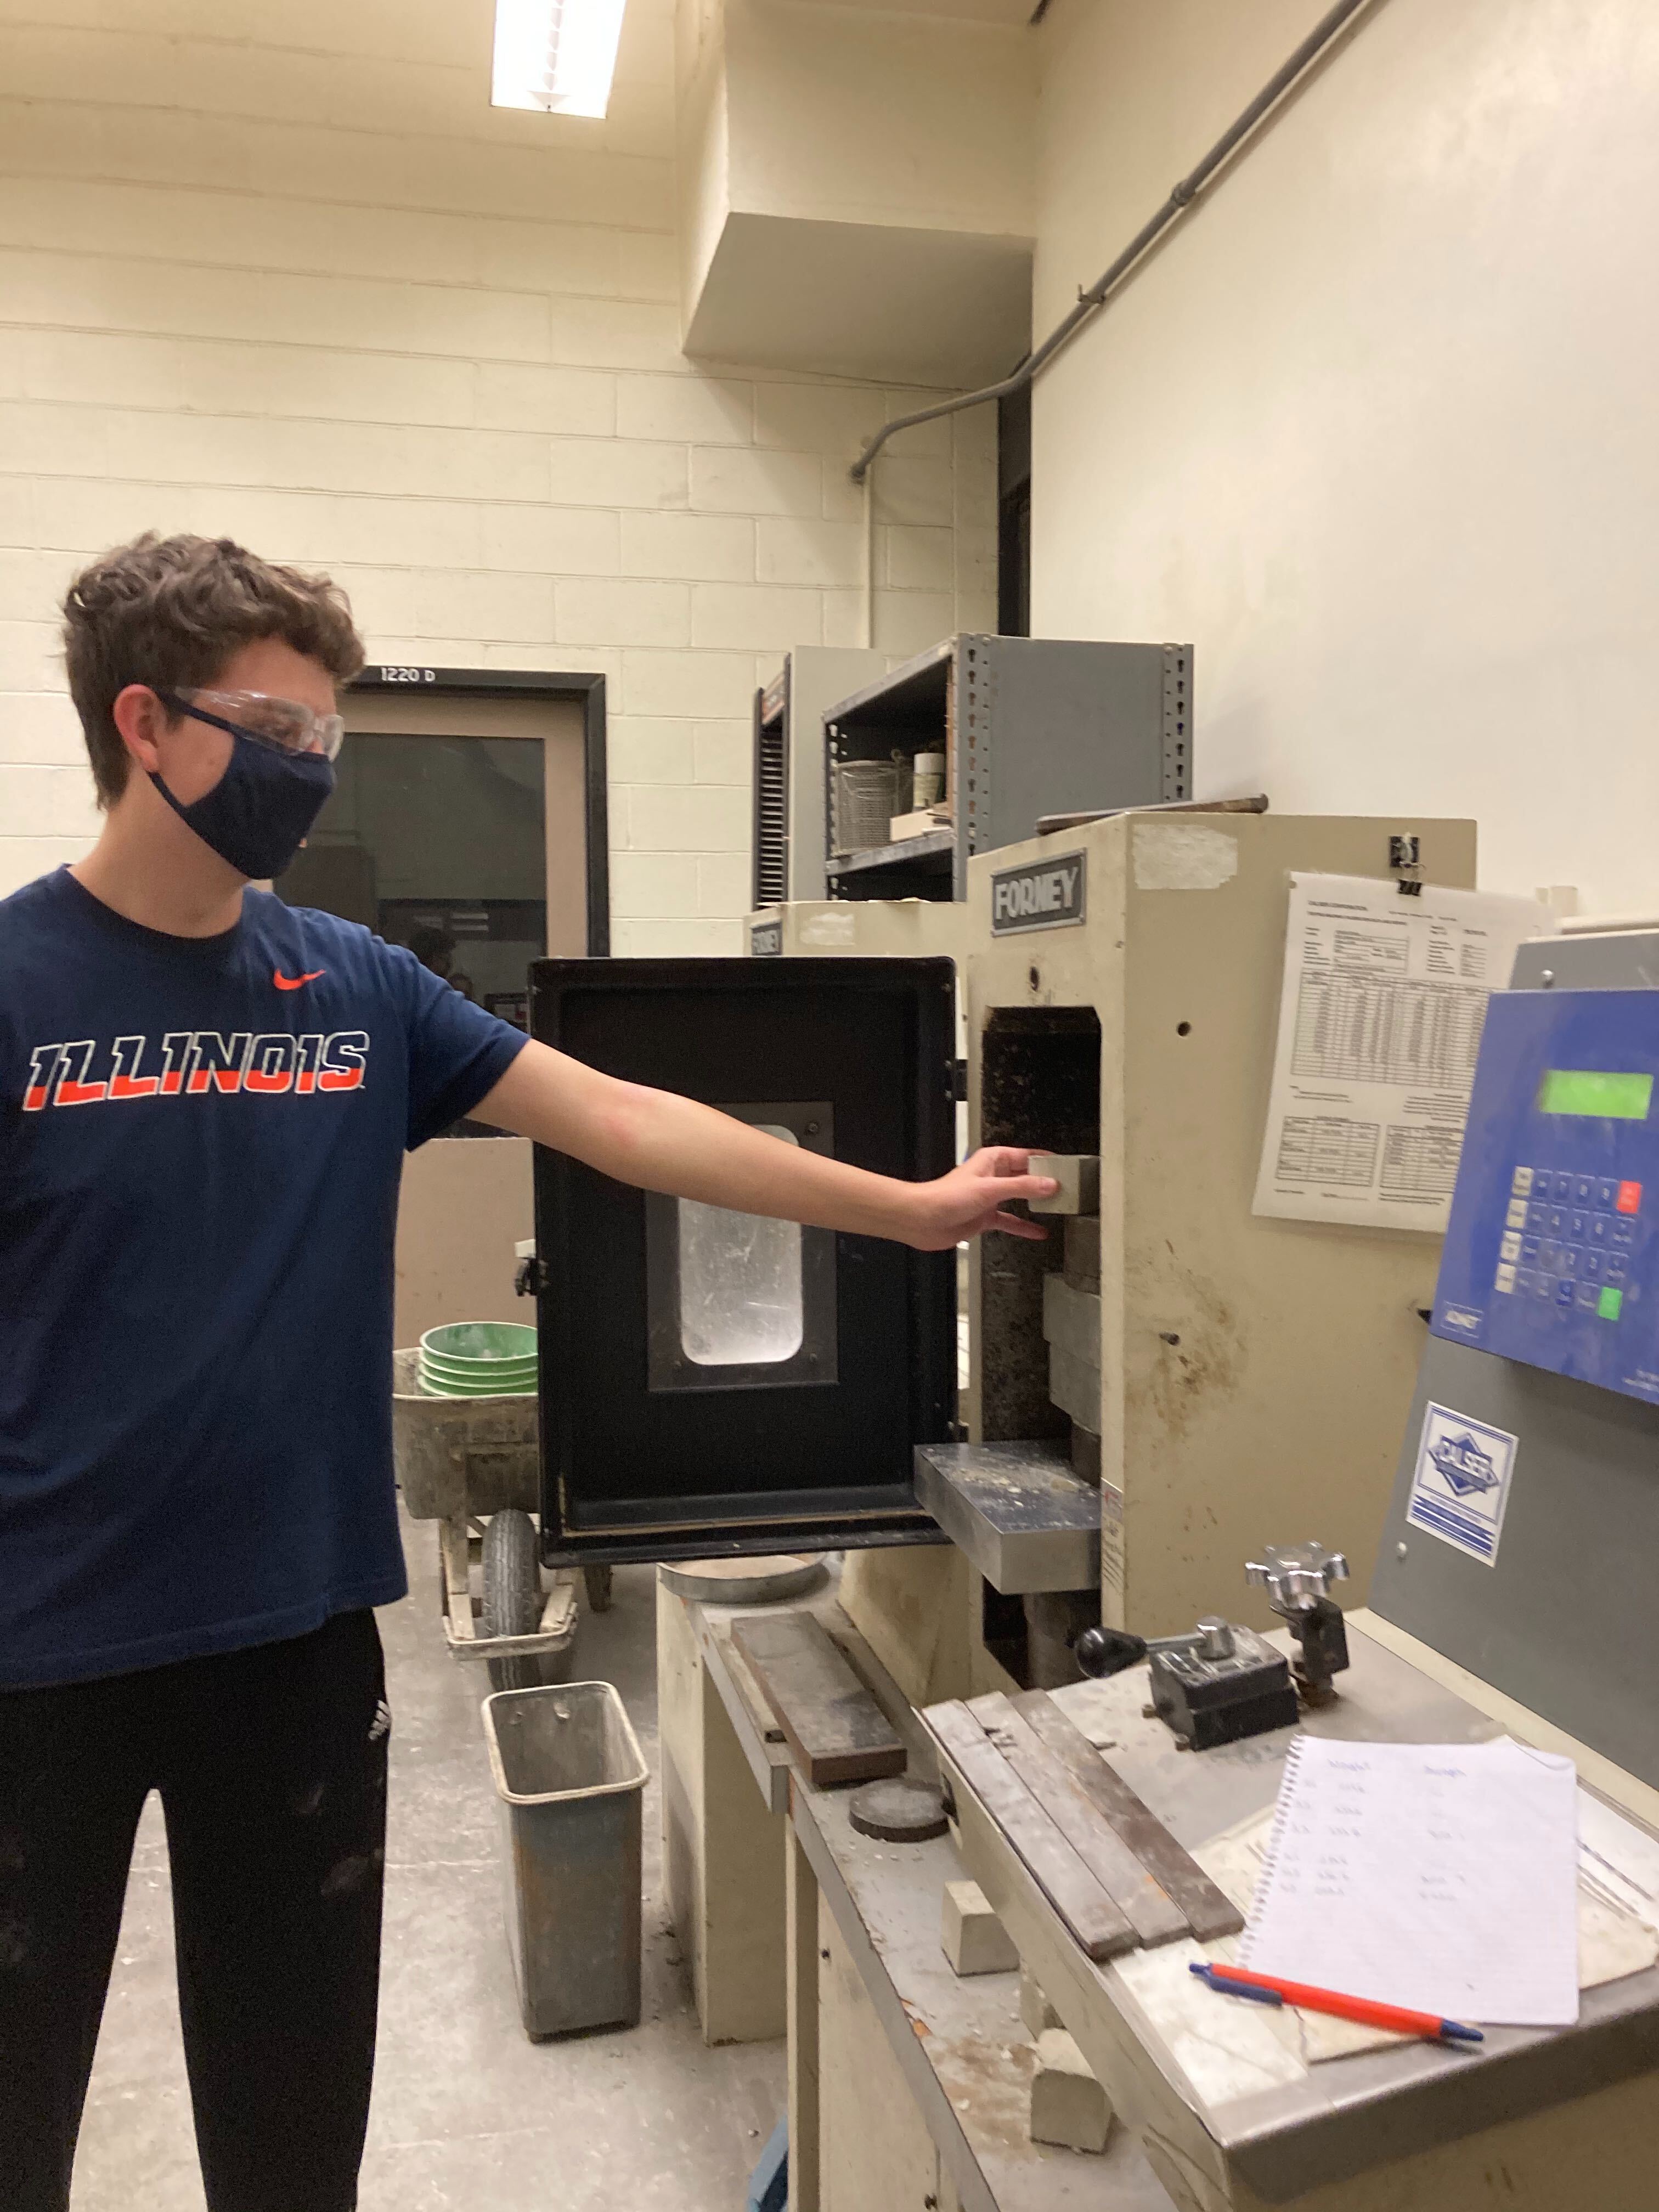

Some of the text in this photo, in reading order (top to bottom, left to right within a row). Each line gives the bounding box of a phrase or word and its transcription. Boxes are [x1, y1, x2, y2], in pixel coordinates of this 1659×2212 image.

[381, 667, 436, 682] 1220 D
[995, 866, 1079, 919] FORNEY
[23, 1031, 370, 1111] ILLINOIS
